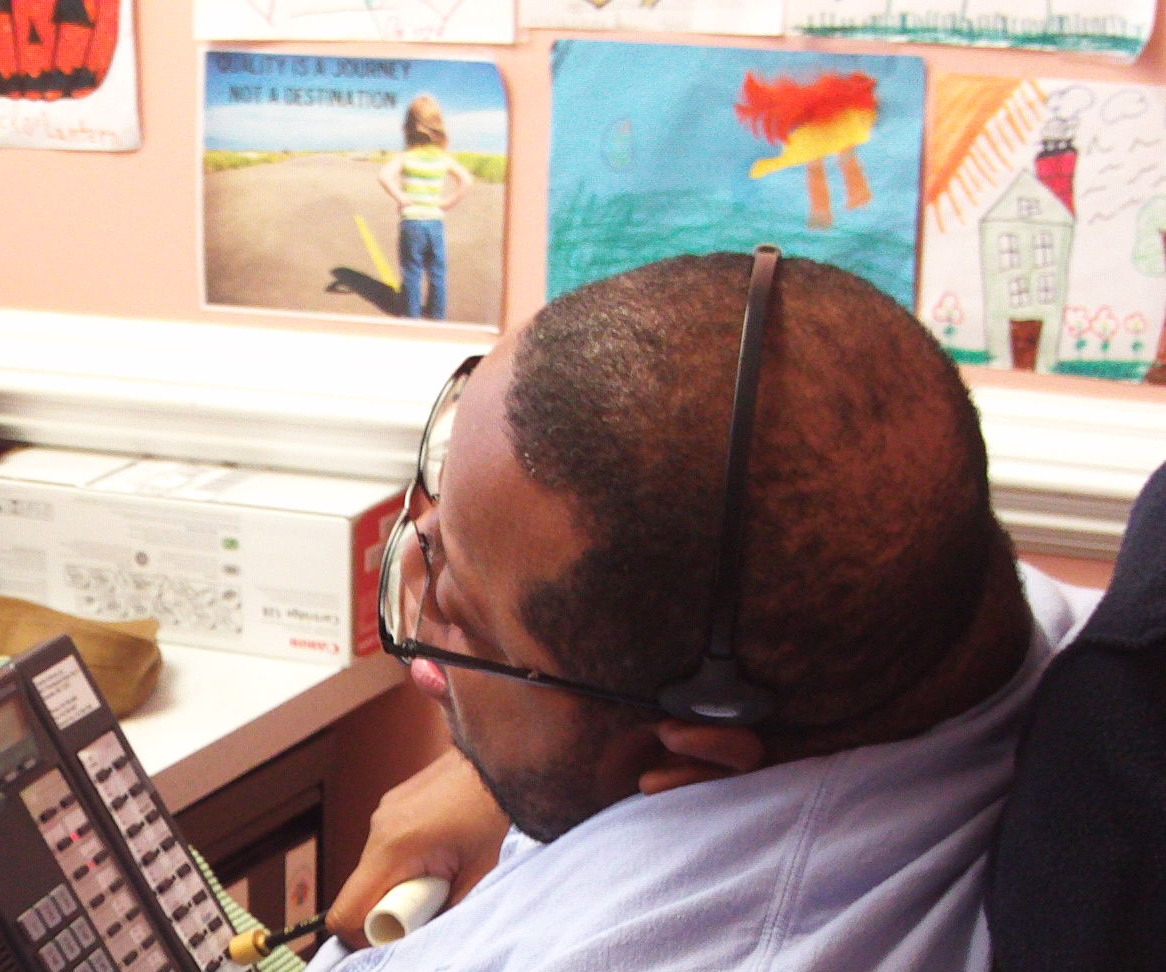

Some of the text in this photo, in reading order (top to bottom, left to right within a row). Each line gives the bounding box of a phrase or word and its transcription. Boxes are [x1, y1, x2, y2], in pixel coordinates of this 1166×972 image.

[334, 57, 411, 79] JOURNEY
[229, 85, 398, 109] NOT A DESTINATION
